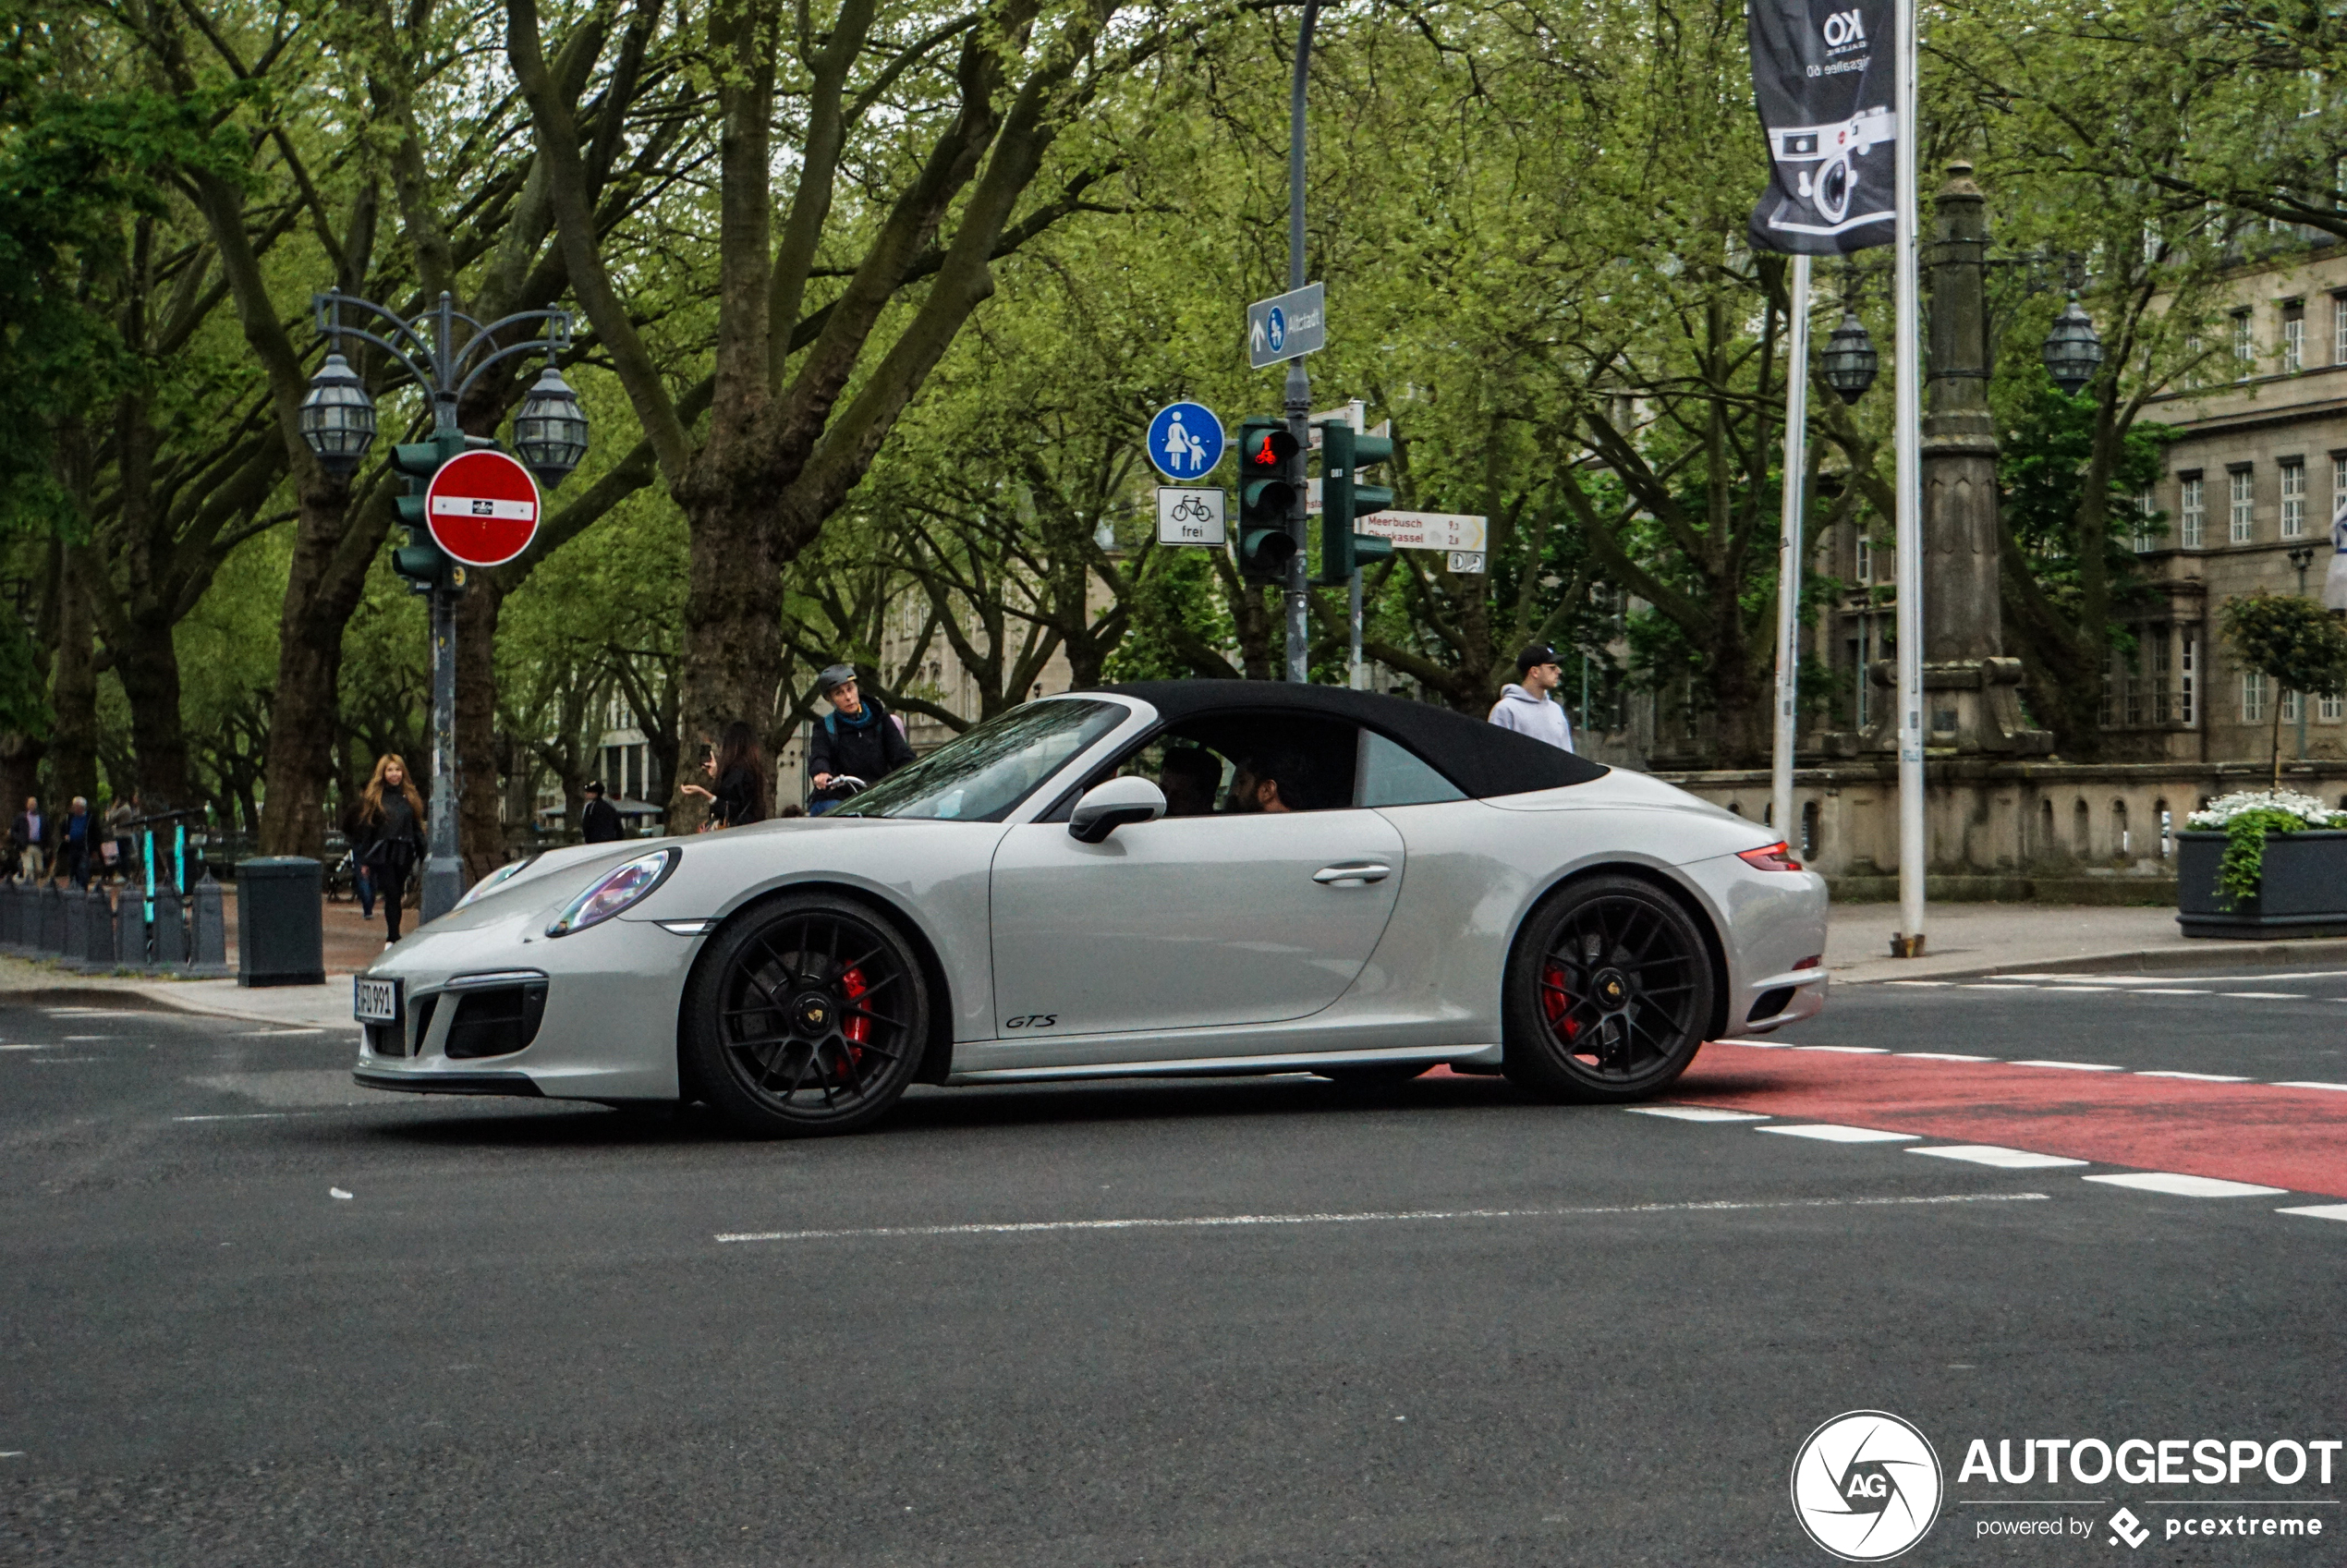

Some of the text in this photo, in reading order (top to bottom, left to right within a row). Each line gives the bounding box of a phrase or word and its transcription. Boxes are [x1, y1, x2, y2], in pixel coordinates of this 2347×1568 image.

[1368, 516, 1422, 529] Meerbusch
[1182, 526, 1203, 537] frei
[373, 985, 391, 1014] 991
[1006, 1015, 1058, 1028] GTS
